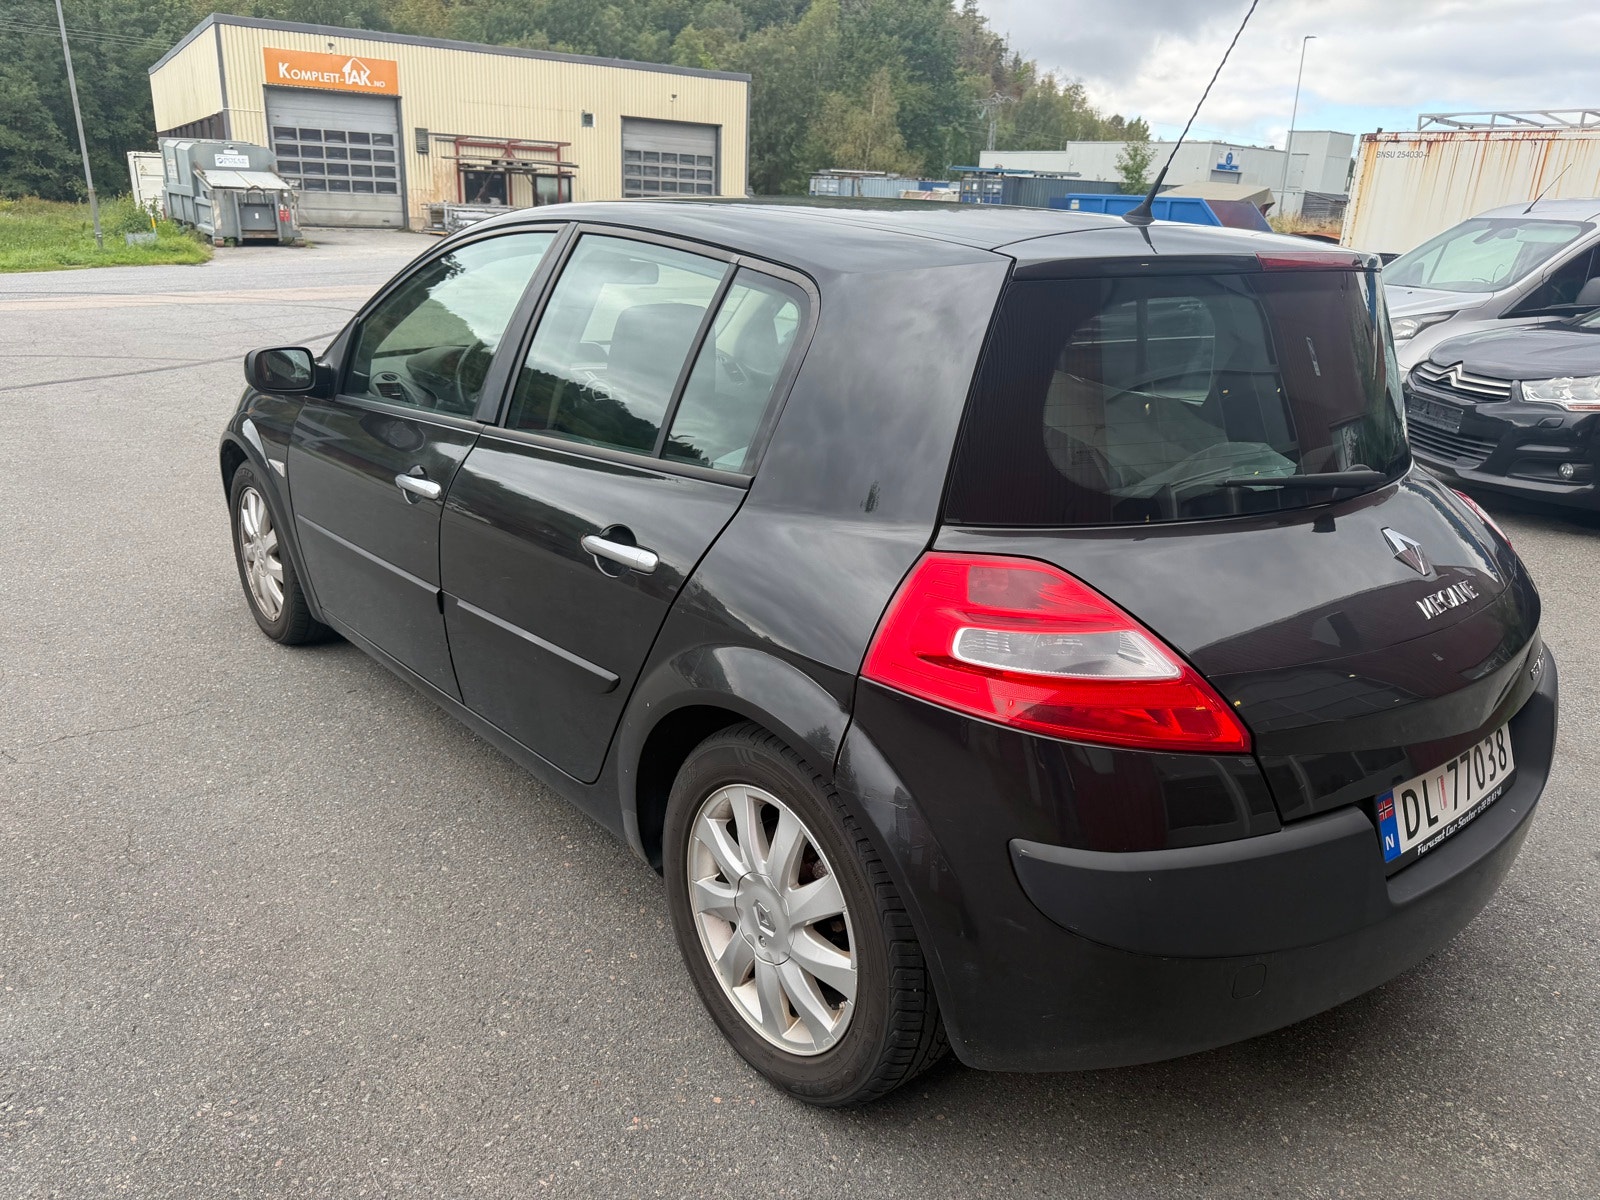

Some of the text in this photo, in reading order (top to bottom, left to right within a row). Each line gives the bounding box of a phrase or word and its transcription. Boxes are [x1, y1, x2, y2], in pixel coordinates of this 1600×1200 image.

[1416, 580, 1479, 620] MEGANE
[1401, 727, 1507, 840] DL 77038
[1385, 833, 1395, 851] N
[1417, 829, 1445, 856] Furuset
[1446, 825, 1458, 837] Car
